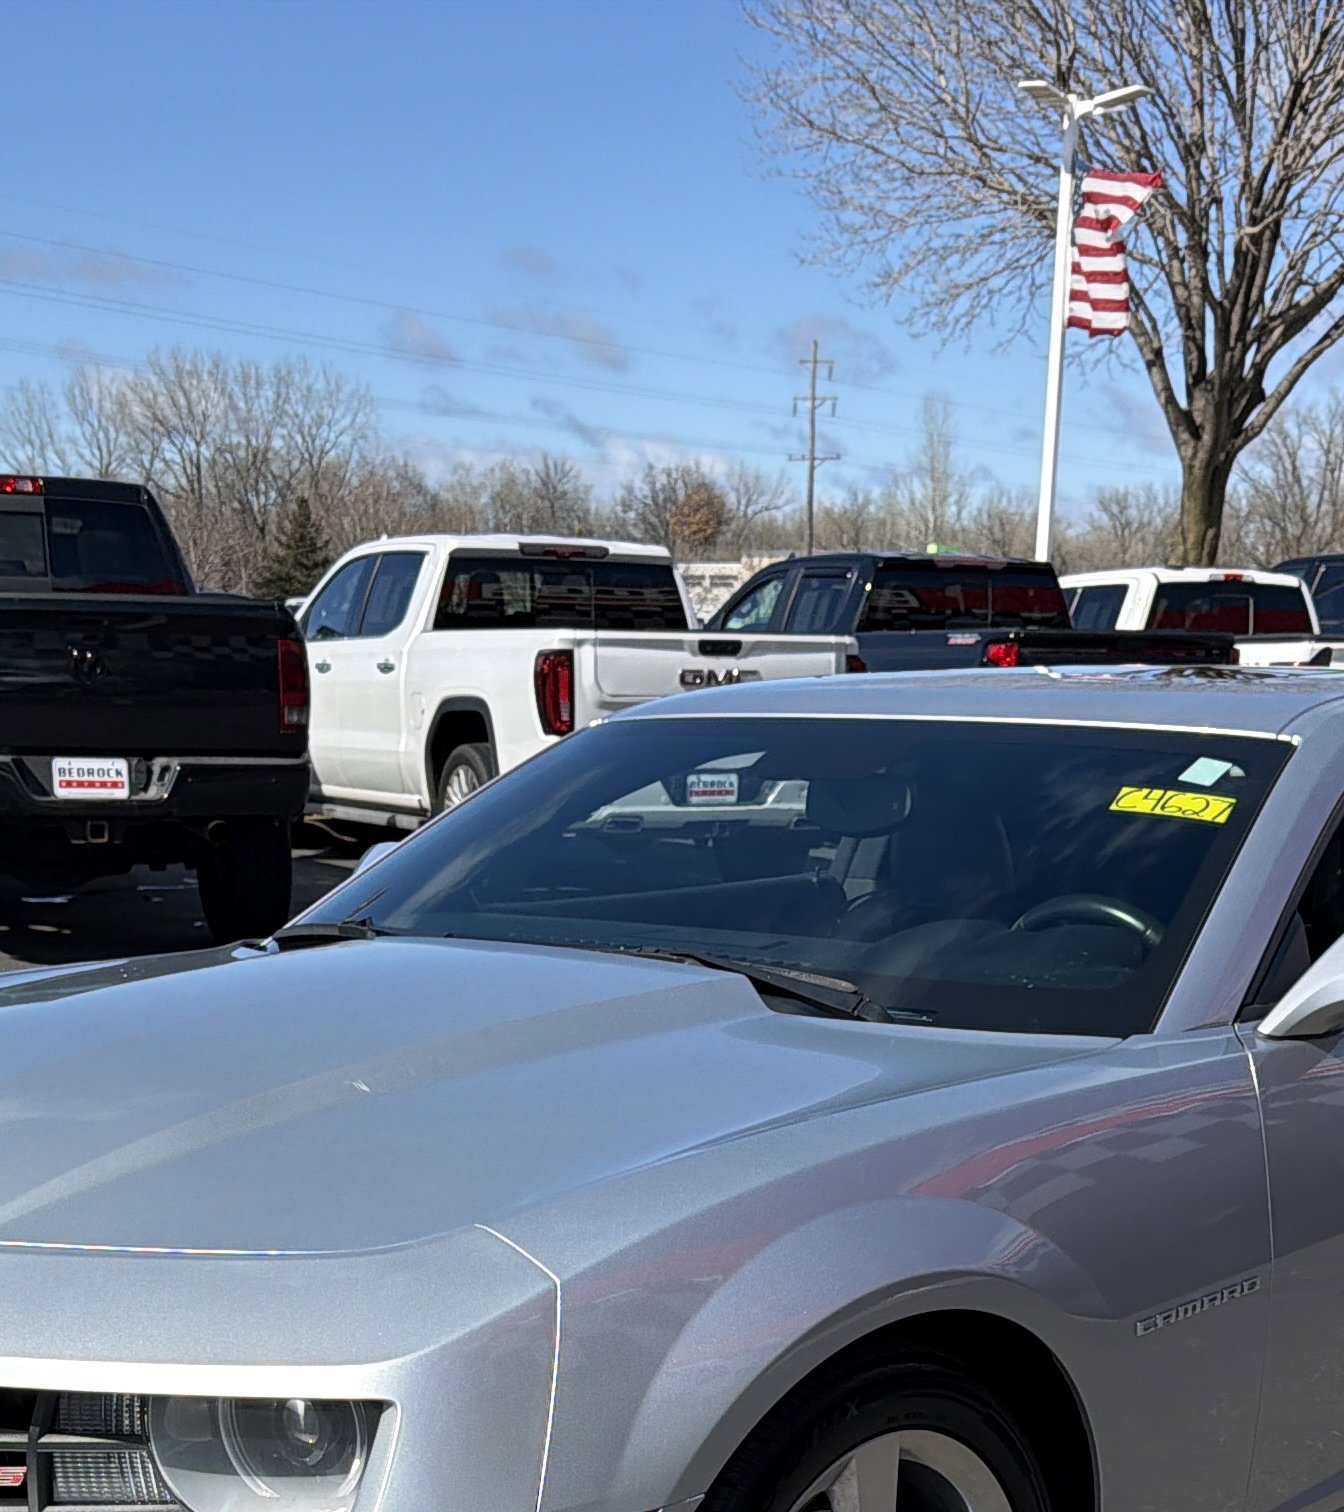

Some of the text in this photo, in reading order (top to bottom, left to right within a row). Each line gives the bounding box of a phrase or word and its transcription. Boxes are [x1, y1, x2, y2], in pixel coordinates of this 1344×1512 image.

[679, 668, 763, 690] GMC
[58, 767, 124, 778] BEDROCK
[1116, 789, 1235, 820] C4627
[1136, 1276, 1261, 1336] CAMARO
